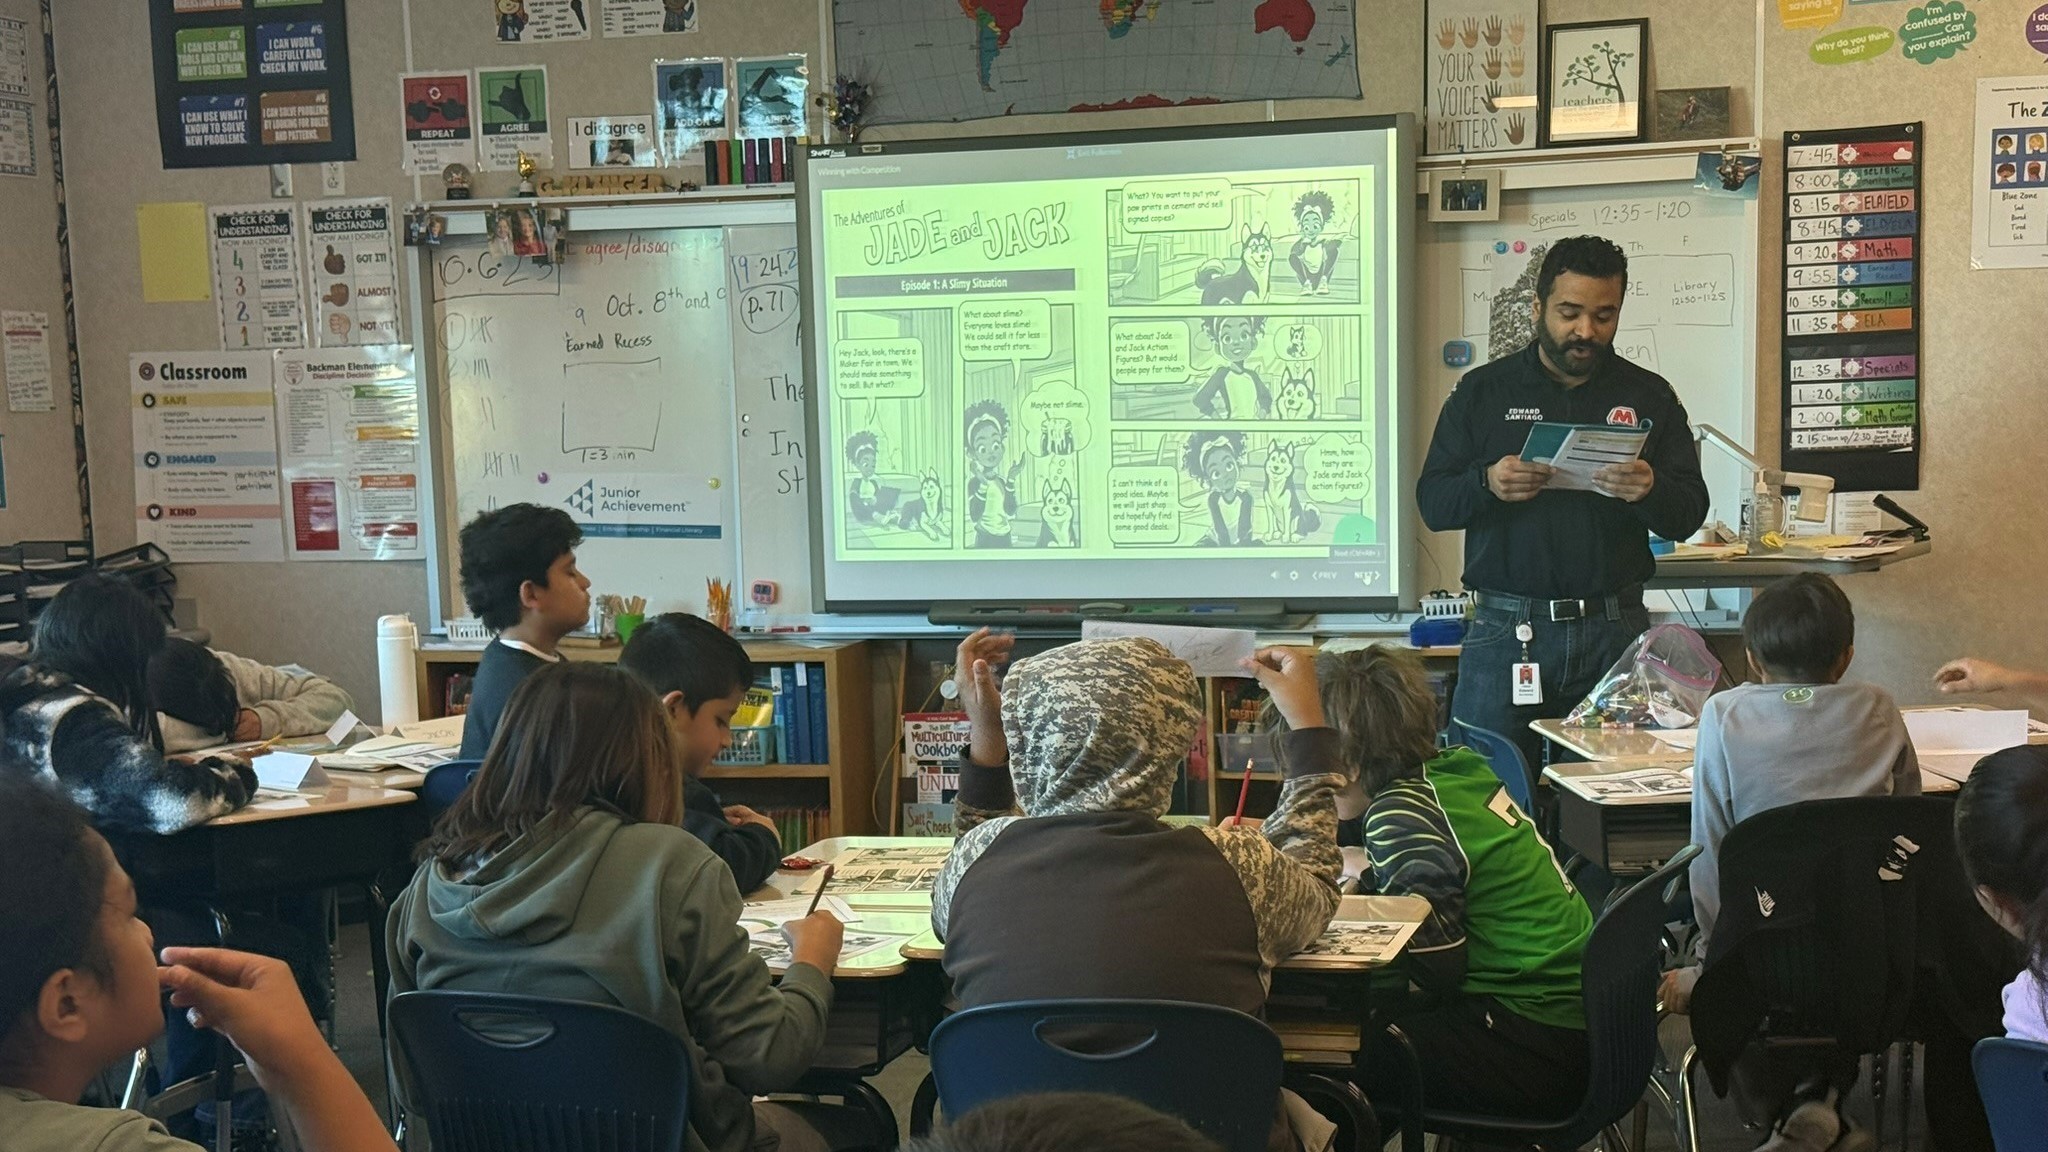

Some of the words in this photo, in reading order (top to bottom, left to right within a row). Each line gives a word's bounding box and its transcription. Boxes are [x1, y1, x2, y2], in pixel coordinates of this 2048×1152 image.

[1926, 7, 1942, 15] I'm
[1905, 14, 1950, 30] confused
[1954, 12, 1968, 20] by
[1944, 24, 1964, 34] Can
[269, 40, 272, 50] I
[274, 38, 290, 50] CAN
[290, 37, 315, 48] WORK
[1816, 42, 1835, 52] Why
[1837, 40, 1849, 48] do
[1850, 36, 1866, 47] you
[1868, 32, 1890, 41] think
[1908, 42, 1926, 54] you
[1928, 32, 1970, 47] explain?
[263, 49, 304, 62] CAREFULLY
[306, 48, 322, 60] AND
[1842, 45, 1865, 56] that?
[260, 62, 286, 74] CHECK
[288, 61, 299, 72] MY
[300, 60, 328, 72] WORK.
[1438, 52, 1474, 83] YOUR
[1438, 85, 1479, 117] VOICE
[1564, 95, 1612, 106] teachers
[182, 113, 185, 124] I
[186, 112, 202, 123] CAN
[204, 111, 218, 122] USE
[220, 110, 243, 122] WHAT
[244, 110, 248, 120] I
[2008, 102, 2037, 118] The
[186, 123, 209, 134] KNOW
[210, 122, 220, 134] TO
[222, 121, 246, 132] SOLVE
[421, 130, 455, 138] REPEAT
[500, 123, 530, 132] AGREE
[575, 122, 579, 136] I
[584, 120, 646, 138] disagree
[1438, 118, 1498, 149] MATTERS
[186, 134, 203, 146] NEW
[204, 132, 248, 146] PROBLEMS.
[1794, 148, 1832, 164] 7:45
[1795, 174, 1832, 188] 8:00
[2002, 192, 2018, 200] Blue
[2020, 192, 2038, 200] Zone
[1793, 197, 1830, 212] 8:15
[230, 216, 256, 226] CHECK
[258, 215, 276, 224] FOR
[326, 211, 352, 220] CHECK
[354, 210, 372, 219] FOR
[834, 214, 850, 228] The
[850, 205, 896, 226] Adventures
[896, 200, 906, 214] of
[1530, 210, 1577, 228] Specials
[220, 226, 288, 236] UNDERSTANDING
[314, 220, 384, 232] UNDERSTANDING
[864, 210, 948, 266] JADE
[950, 212, 982, 246] and
[982, 202, 1070, 261] JACK
[1628, 242, 1644, 250] Th
[1794, 246, 1830, 260] 9:20
[1864, 242, 1898, 258] Math
[232, 250, 244, 271] 4
[356, 254, 372, 264] GOT
[375, 253, 387, 262] IT!
[901, 280, 931, 292] Episode
[933, 279, 940, 290] 1:
[942, 279, 948, 289] A
[950, 278, 971, 291] Slimy
[972, 277, 1008, 288] Situation
[1794, 270, 1832, 285] 9:55
[234, 276, 246, 296] 3
[358, 287, 390, 296] ALMOST
[1674, 281, 1717, 294] Library
[606, 293, 643, 317] Oct.
[685, 292, 710, 309] and
[1789, 296, 1826, 308] 10:55
[236, 301, 250, 322] 2
[360, 322, 376, 332] NOT
[380, 322, 394, 330] YET
[1792, 317, 1828, 332] 11:35
[1865, 314, 1886, 328] ELA
[240, 326, 249, 346] 1
[566, 333, 604, 352] Earned
[614, 332, 652, 348] Recess
[1156, 332, 1172, 340] Jade
[1115, 344, 1127, 352] and
[1129, 344, 1144, 352] Jack
[1116, 354, 1144, 365] Figures?
[1146, 354, 1157, 362] But
[1158, 354, 1178, 362] would
[160, 363, 248, 381] Classroom
[306, 363, 346, 372] Backman
[1116, 366, 1136, 376] people
[1138, 368, 1150, 376] pay
[1152, 365, 1162, 374] for
[1164, 364, 1186, 373] them?
[1793, 364, 1830, 378] 12:35
[1864, 362, 1908, 378] Specials
[312, 372, 344, 380] Discipline
[765, 374, 804, 401] The
[1799, 388, 1832, 402] 1:20
[1867, 387, 1912, 400] Writing
[1031, 402, 1051, 411] Maybe
[1613, 410, 1632, 424] M
[1800, 412, 1834, 424] 2:00
[1866, 408, 1888, 424] Math
[769, 430, 803, 458] In
[1341, 448, 1354, 456] how
[166, 455, 216, 464] ENGAGED
[1322, 460, 1340, 470] tasty
[1312, 470, 1330, 479] Jade
[1332, 470, 1344, 478] and
[1346, 470, 1362, 479] Jack
[600, 486, 640, 498] Junior
[1312, 482, 1333, 490] action
[1335, 482, 1363, 492] figures?
[169, 508, 197, 517] KIND
[600, 500, 686, 512] Achievement
[1355, 532, 1360, 543] 2
[911, 731, 972, 742] Multicultural
[915, 743, 967, 758] Cookboo
[926, 820, 952, 837] Shoes
